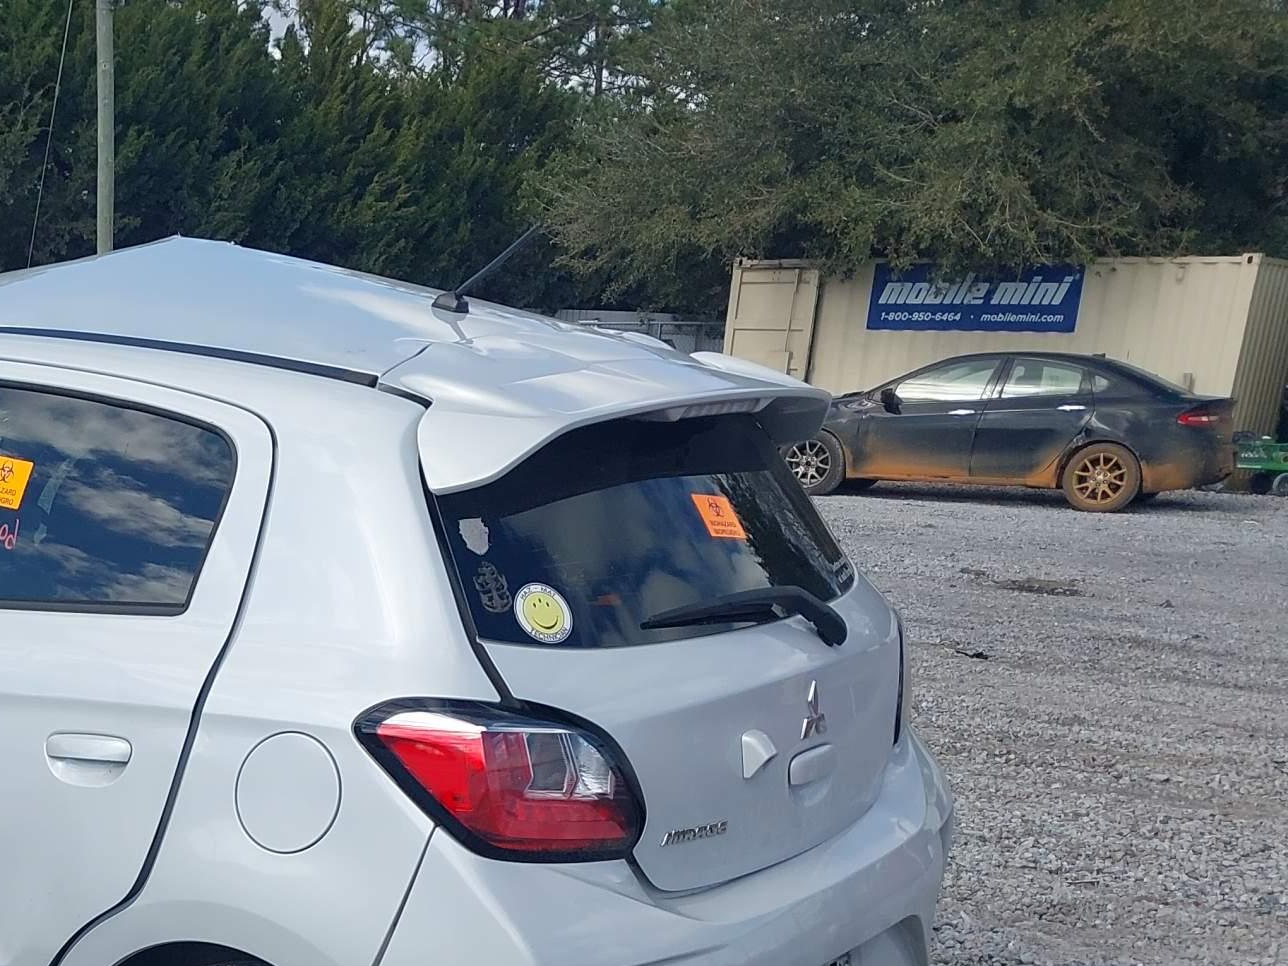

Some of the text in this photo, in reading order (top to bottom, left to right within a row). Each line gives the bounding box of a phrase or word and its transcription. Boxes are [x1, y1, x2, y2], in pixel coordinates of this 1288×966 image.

[990, 276, 1074, 305] mini
[880, 311, 1064, 323] 1-800-950-6464 mobilemini.com
